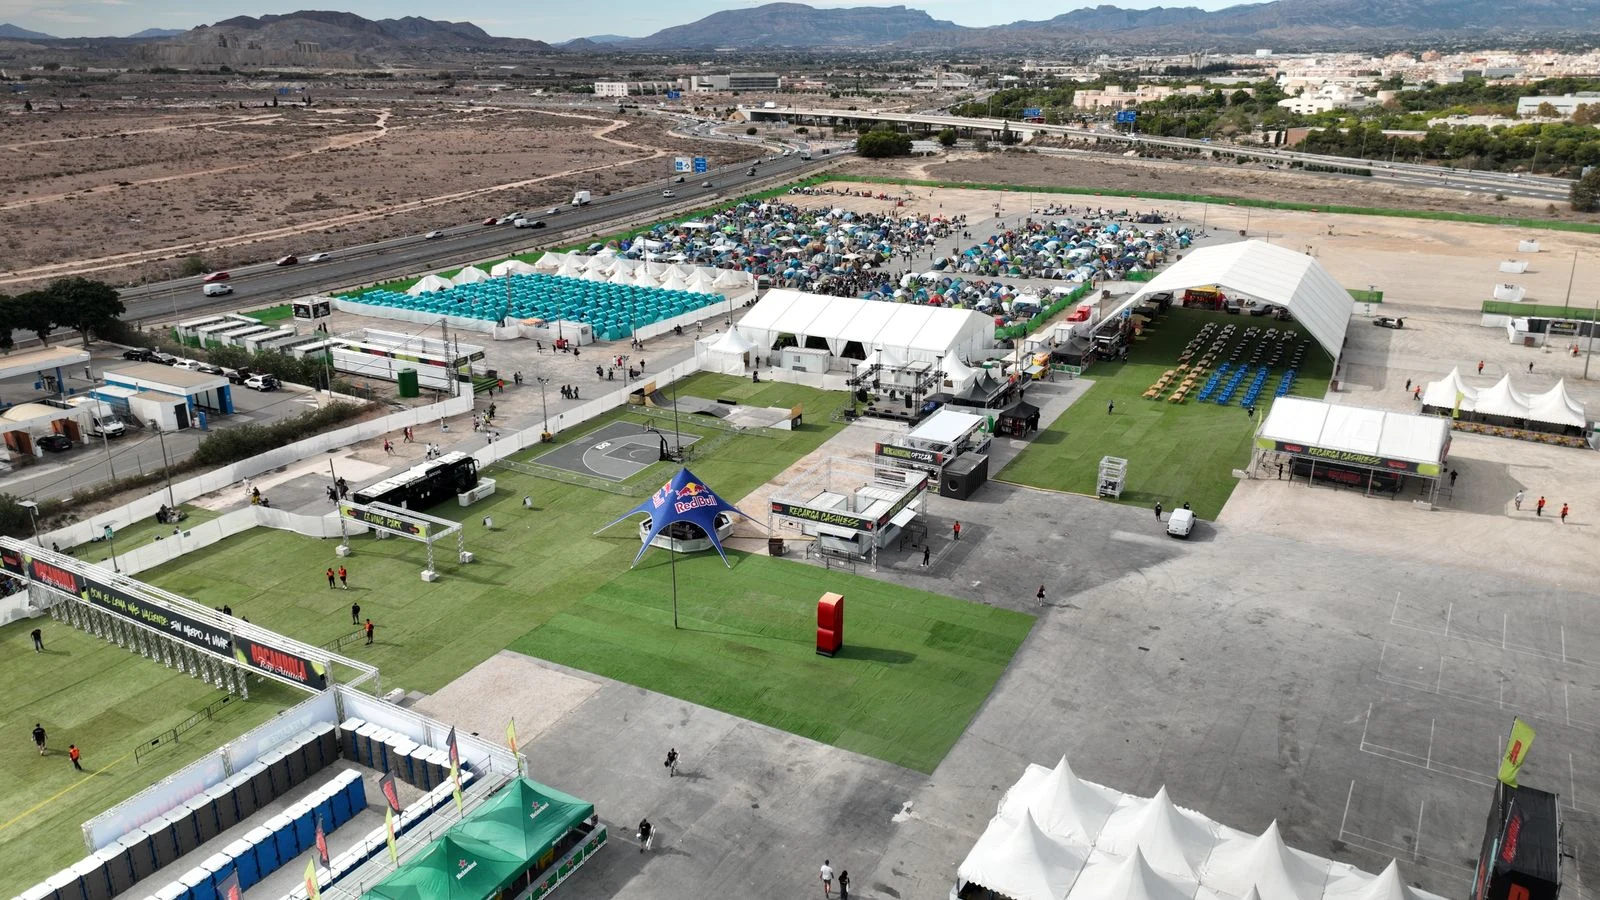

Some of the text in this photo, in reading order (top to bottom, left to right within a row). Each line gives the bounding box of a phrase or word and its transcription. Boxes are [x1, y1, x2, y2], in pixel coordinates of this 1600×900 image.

[1308, 447, 1340, 460] RECARGA
[1340, 452, 1381, 465] CASHLESS
[675, 494, 718, 514] Red Bull
[789, 506, 819, 521] RECARGA
[820, 512, 860, 527] CASHLESS
[170, 620, 183, 634] SIN
